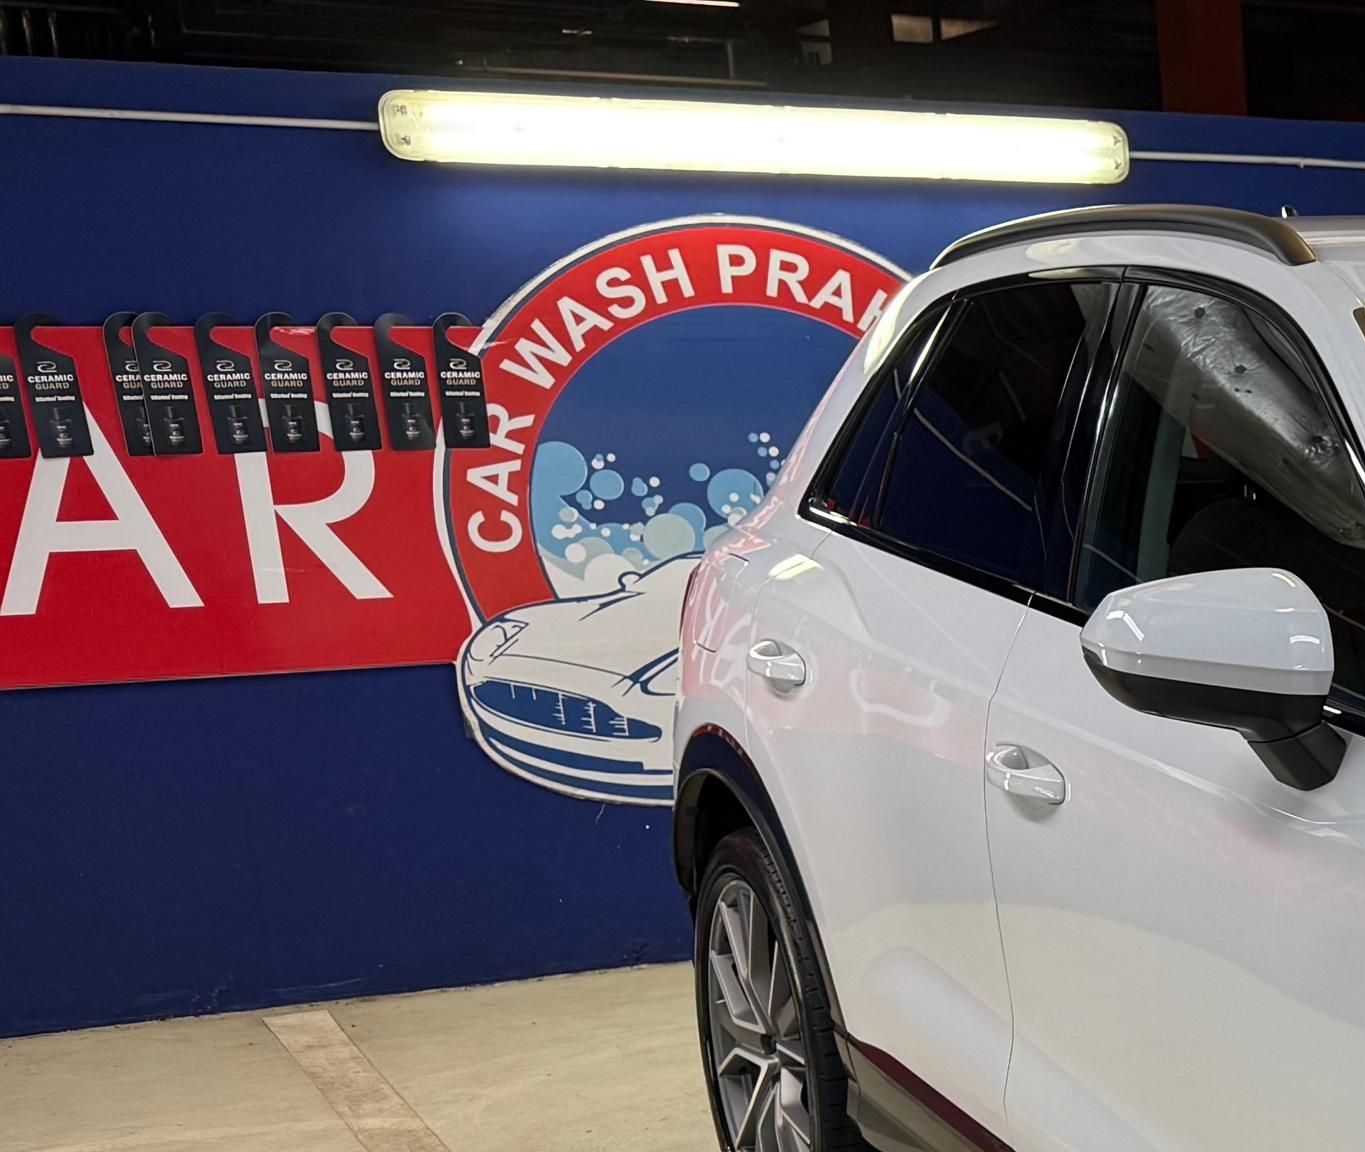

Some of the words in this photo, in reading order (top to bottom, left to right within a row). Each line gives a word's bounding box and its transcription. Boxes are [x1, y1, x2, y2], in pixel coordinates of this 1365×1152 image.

[500, 248, 695, 390] WASH
[27, 374, 74, 383] CERAMIC
[115, 374, 142, 383] CERA
[144, 373, 188, 382] CERAMIC
[207, 372, 251, 381] CERAMIC
[264, 372, 308, 380] CERAMIC
[326, 371, 368, 379] CERAMIC
[384, 371, 425, 379] CERAMIC
[440, 370, 480, 379] CERAMIC
[35, 381, 70, 391] GUARD
[150, 381, 183, 389] GUARD
[214, 380, 246, 388] GUARD
[271, 379, 303, 388] GUARD
[332, 379, 364, 387] GUARD
[390, 378, 421, 386] GUARD
[446, 378, 476, 386] GUARD
[466, 403, 535, 553] CAR
